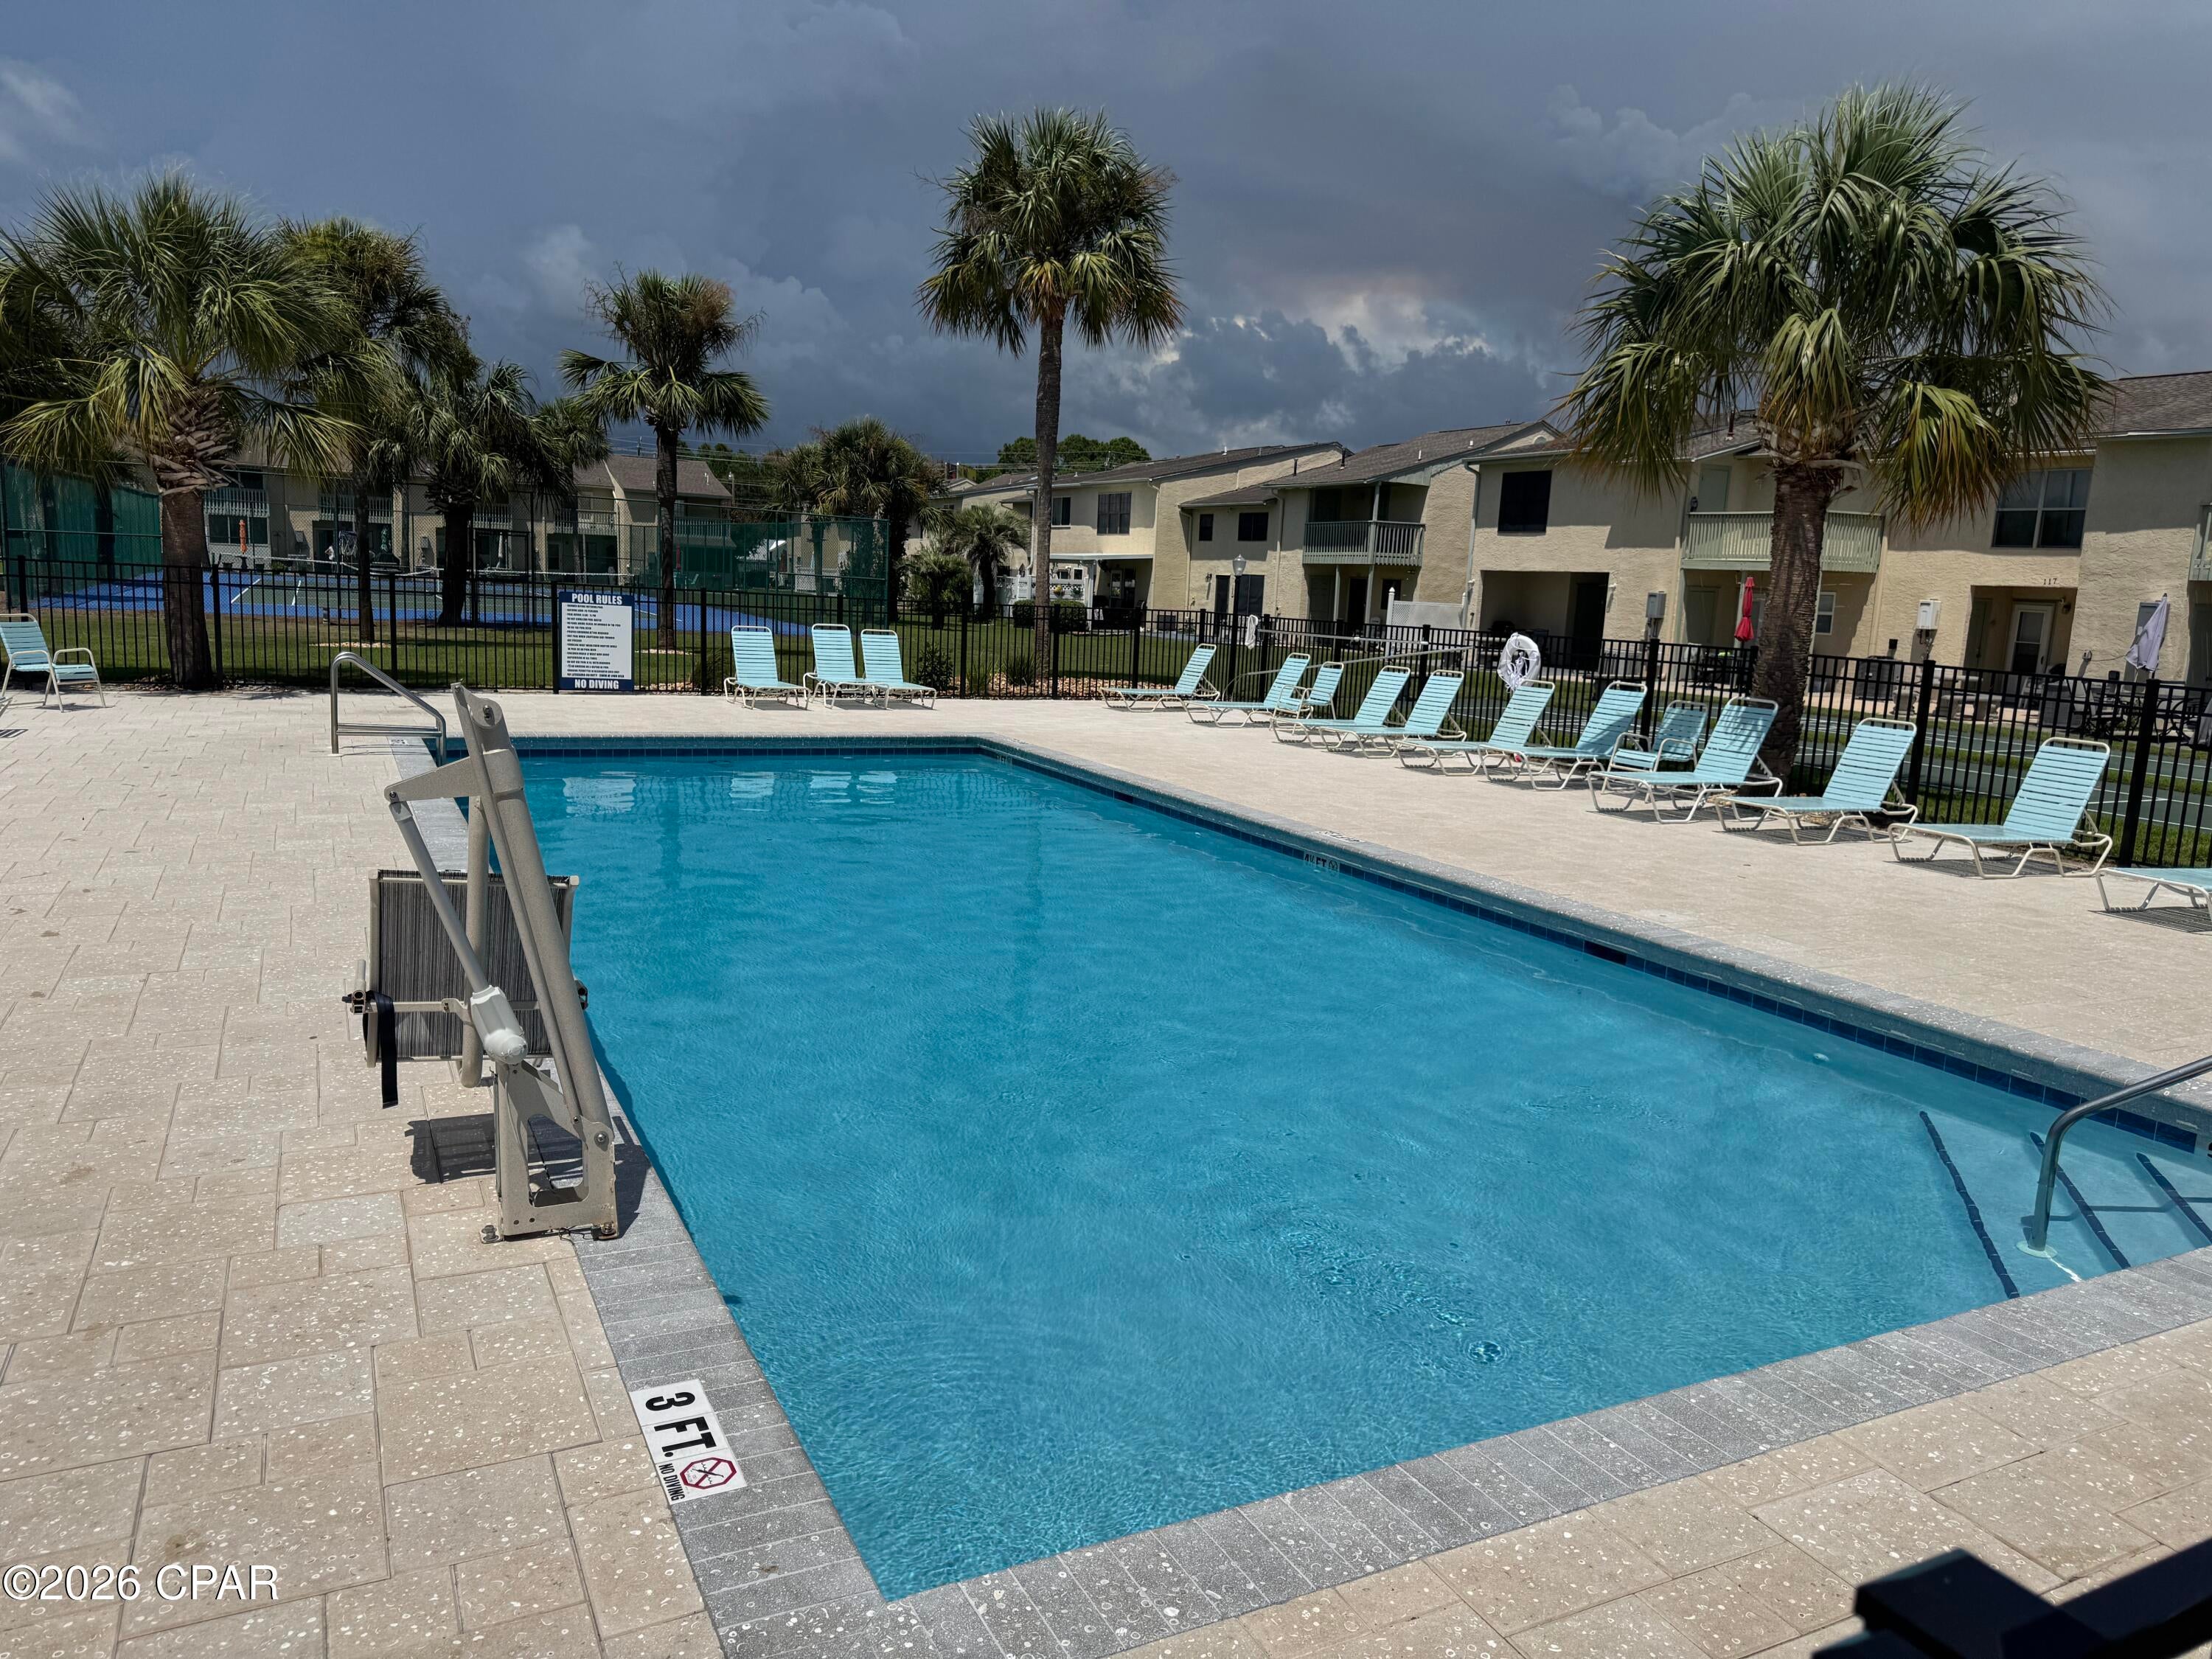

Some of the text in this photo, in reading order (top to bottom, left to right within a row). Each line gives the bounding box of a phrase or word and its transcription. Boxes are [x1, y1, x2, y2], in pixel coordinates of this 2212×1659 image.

[571, 593, 622, 605] POOL RULES
[574, 678, 619, 689] NO DIVING
[645, 1391, 717, 1458] 3 FT.
[658, 1463, 686, 1502] NO DIVING
